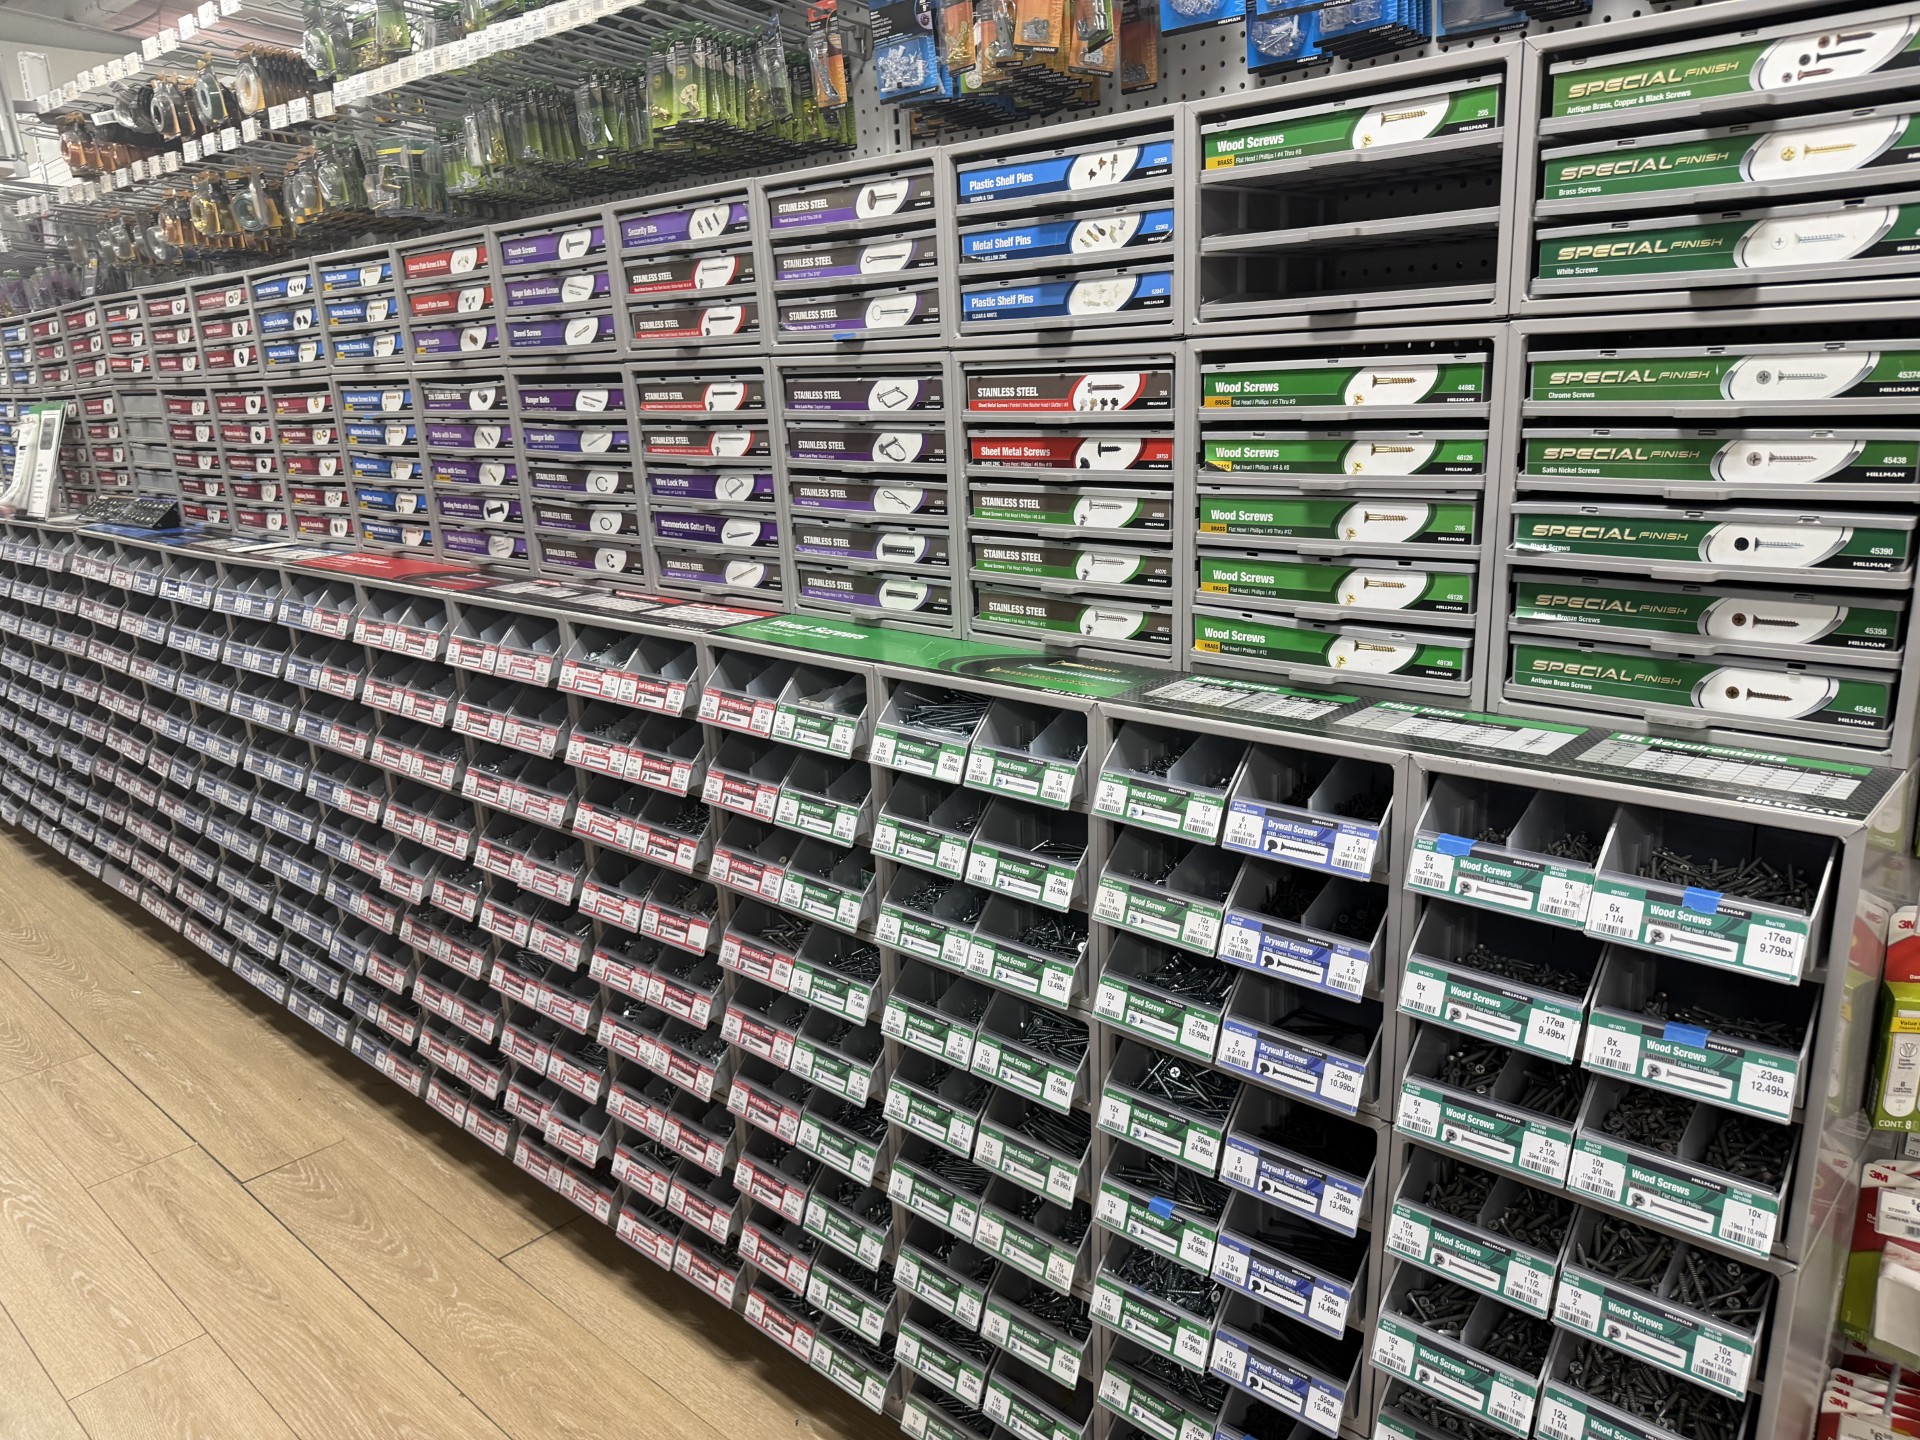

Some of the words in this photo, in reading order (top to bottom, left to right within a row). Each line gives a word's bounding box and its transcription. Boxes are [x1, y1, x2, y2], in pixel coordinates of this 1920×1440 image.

[1567, 67, 1682, 99] SPECIAL
[1682, 61, 1740, 79] FINISH
[1567, 105, 1591, 114] Antique
[1593, 102, 1612, 110] Brass,
[1614, 98, 1637, 107] Copper
[1645, 93, 1664, 102] Black
[1665, 90, 1691, 100] Screws
[1217, 136, 1244, 152] Wood
[1247, 132, 1285, 148] Screws
[970, 178, 994, 191] Plastic
[996, 175, 1015, 186] Shelf
[1016, 173, 1033, 183] Pins
[1558, 187, 1576, 196] Brass
[1578, 185, 1602, 195] Screws
[778, 201, 810, 213] STAINLESS
[811, 199, 828, 208] STEEL
[628, 226, 646, 236] Security
[648, 225, 657, 233] Bits
[973, 240, 993, 251] Metal
[995, 237, 1013, 247] Shelf
[1015, 234, 1031, 245] Pins
[1557, 240, 1669, 261] SPECIAL
[1670, 237, 1724, 249] FINISH
[508, 247, 521, 255] Thumb
[633, 273, 657, 283] STAINLESS
[658, 272, 672, 281] STEEL
[1556, 267, 1574, 276] White
[1575, 265, 1598, 274] Screws
[971, 298, 996, 308] Plastic
[998, 295, 1016, 306] Shelf
[1017, 294, 1033, 303] Pins
[1549, 370, 1659, 385] SPECIAL
[1659, 370, 1710, 380] FINISH
[978, 388, 1015, 397] STAINLESS
[1016, 387, 1038, 396] STEEL
[1215, 382, 1241, 393] Wood
[1243, 380, 1279, 392] Screws
[525, 396, 539, 404] Hanger
[794, 391, 822, 399] STAINLESS
[824, 391, 841, 399] STEEL
[1571, 391, 1595, 399] Screws
[981, 447, 1000, 456] Sheet
[1002, 447, 1022, 456] Metal
[1024, 447, 1051, 456] Screws
[1215, 447, 1241, 458] Wood
[1244, 447, 1279, 458] Screws
[1543, 447, 1649, 461] SPECIAL
[1650, 450, 1700, 459] FINISH
[1883, 456, 1907, 465] 45438
[1542, 466, 1559, 474] Satin
[656, 478, 665, 486] Wire
[678, 479, 689, 487] Pins
[981, 497, 1017, 508] STAINLESS
[1019, 499, 1040, 509] STEEL
[1210, 510, 1236, 521] Wood
[1239, 511, 1273, 522] Screws
[661, 520, 689, 530] Hammerlock
[690, 522, 703, 531] Cotter
[705, 524, 715, 532] Pins
[1532, 525, 1637, 541] SPECIAL
[1638, 531, 1688, 542] FINISH
[1869, 547, 1893, 555] 45390
[1213, 570, 1238, 581] Wood
[1240, 572, 1275, 584] Screws
[988, 602, 1024, 615] STAINLESS
[1025, 605, 1047, 616] STEEL
[1534, 594, 1637, 614] SPECIAL
[1639, 604, 1687, 615] FINISH
[768, 620, 811, 631] Wood
[810, 625, 869, 640] Screws
[1204, 628, 1229, 640] Wood
[1231, 631, 1266, 643] Screws
[1864, 627, 1887, 635] 45358
[1531, 659, 1632, 682] SPECIAL
[1635, 673, 1682, 686] FINISH
[1531, 677, 1552, 686] Antique
[1553, 679, 1569, 688] Brass
[1571, 681, 1592, 691] Screws
[1854, 705, 1877, 714] 45454
[1838, 717, 1876, 726] HILLMAN
[1648, 737, 1789, 762] Requirements
[1736, 795, 1849, 818] HILLMAN
[1268, 820, 1292, 833] Drywall
[1293, 824, 1318, 836] Screws
[1424, 862, 1434, 870] 3/4
[1460, 859, 1481, 871] Wood
[1482, 865, 1512, 878] Screws
[1609, 904, 1620, 913] 6x
[1650, 904, 1675, 919] Wood
[1677, 909, 1712, 926] Screws
[1605, 913, 1609, 921] 1
[1611, 913, 1624, 924] 1/4
[1898, 920, 1914, 929] 3M
[1764, 931, 1792, 945] .17ea
[1759, 943, 1794, 959] 9.79bx
[996, 953, 1010, 965] Wood
[1012, 957, 1027, 968] Screws
[1416, 982, 1426, 991] 8x
[1418, 991, 1422, 999] 1
[1450, 986, 1470, 1000] Wood
[1472, 992, 1501, 1008] Screws
[1130, 995, 1145, 1008] Wood
[1147, 1001, 1165, 1014] Screws
[1542, 1016, 1565, 1029] .17ea
[1188, 1028, 1210, 1042] 15.99bx
[1538, 1026, 1566, 1041] 9.49bx
[1607, 1036, 1618, 1046] 8x
[1260, 1043, 1282, 1058] Drywall
[1284, 1050, 1308, 1065] Screws
[1602, 1046, 1606, 1055] 1
[1608, 1047, 1621, 1058] 1/2
[1646, 1040, 1671, 1054] Wood
[1673, 1045, 1707, 1063] Screws
[1334, 1069, 1352, 1082] .23ea
[1757, 1069, 1784, 1084] .23ea
[1330, 1078, 1356, 1094] 10.99bx
[1750, 1081, 1789, 1099] 12.49bx
[1446, 1107, 1466, 1121] Wood
[1467, 1114, 1495, 1130] Screws
[1879, 1120, 1903, 1129] CONT.
[1905, 1120, 1911, 1130] 8
[1591, 1166, 1602, 1176] 3/4
[1869, 1170, 1888, 1183] 3M
[1632, 1169, 1655, 1184] Wood
[1657, 1176, 1690, 1196] Screws
[1333, 1192, 1351, 1205] .30ea
[1328, 1200, 1354, 1216] 13.49bx
[1252, 1260, 1274, 1277] Drywall
[1274, 1270, 1297, 1287] Screws
[1317, 1304, 1342, 1319] 14.49bx
[1608, 1301, 1630, 1317] Wood
[1632, 1308, 1664, 1331] Screws
[1313, 1403, 1337, 1420] 15.49bx
